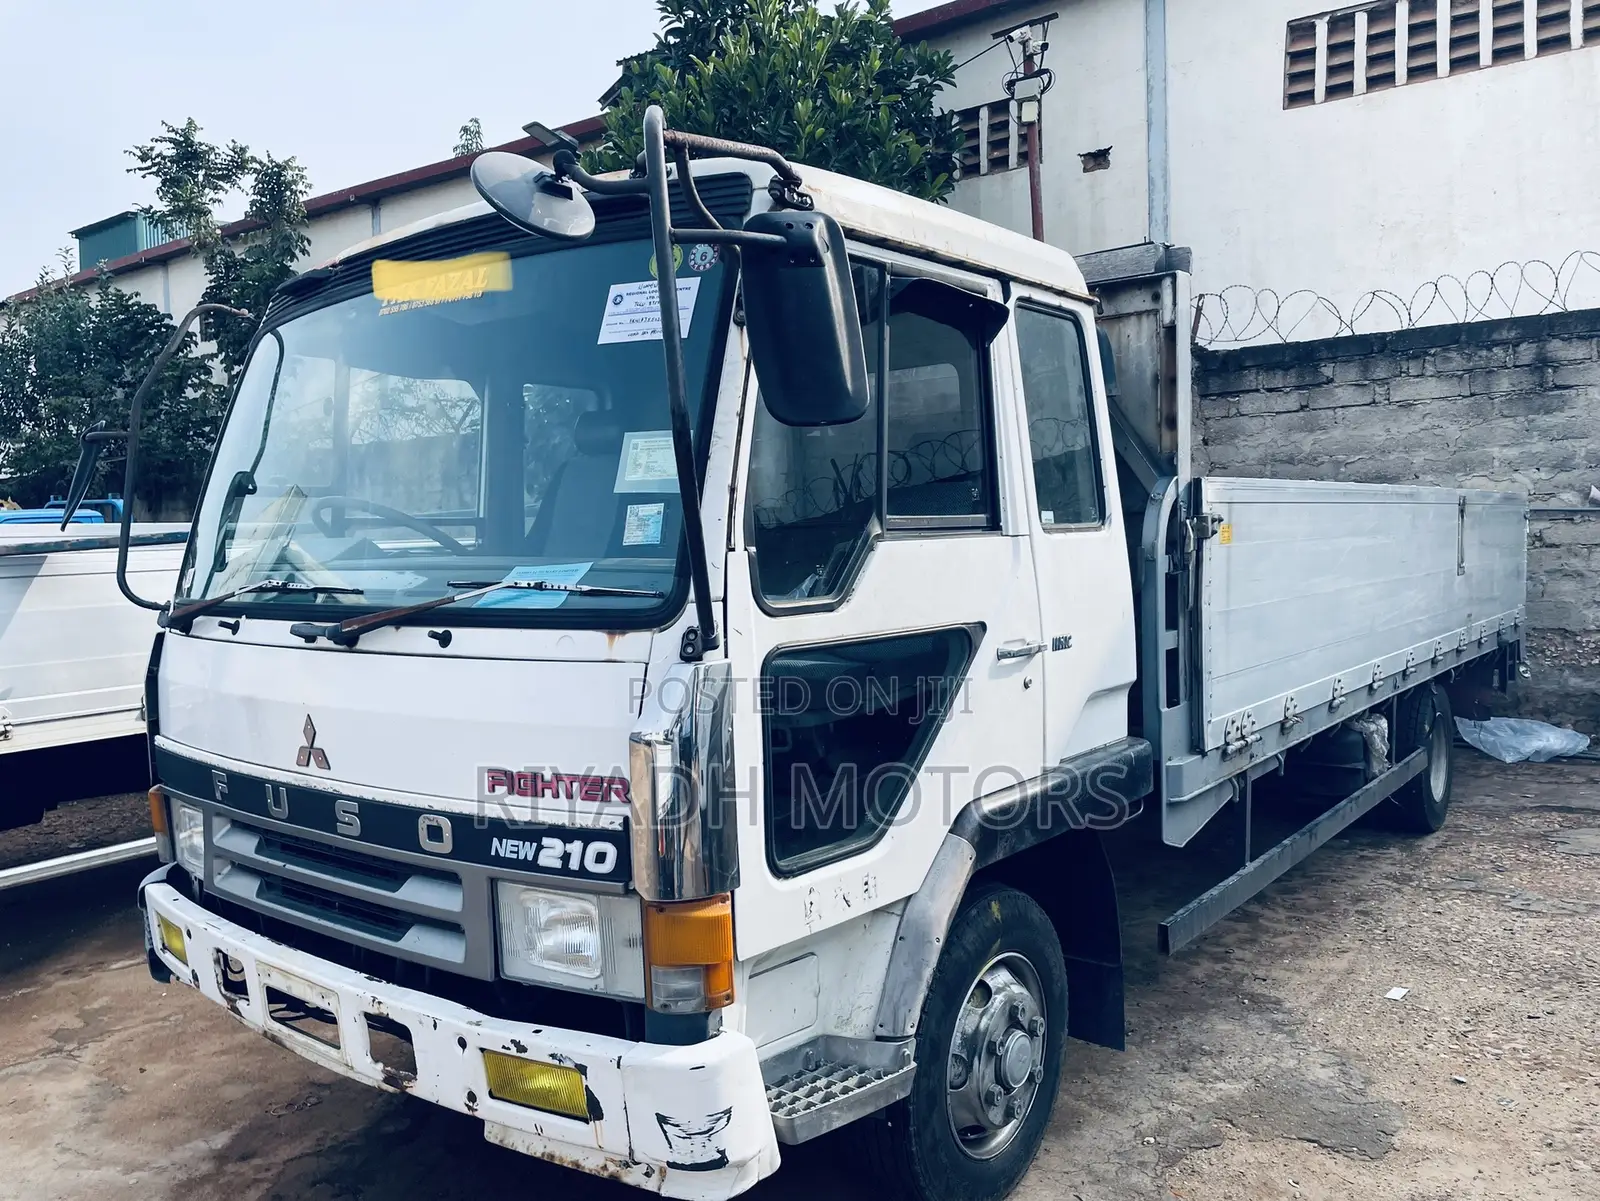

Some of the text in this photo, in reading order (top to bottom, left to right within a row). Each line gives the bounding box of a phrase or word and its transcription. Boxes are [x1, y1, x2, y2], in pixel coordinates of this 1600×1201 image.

[487, 768, 632, 804] FIGHTER
[211, 769, 453, 855] FUSO
[490, 836, 618, 874] NEW 210
